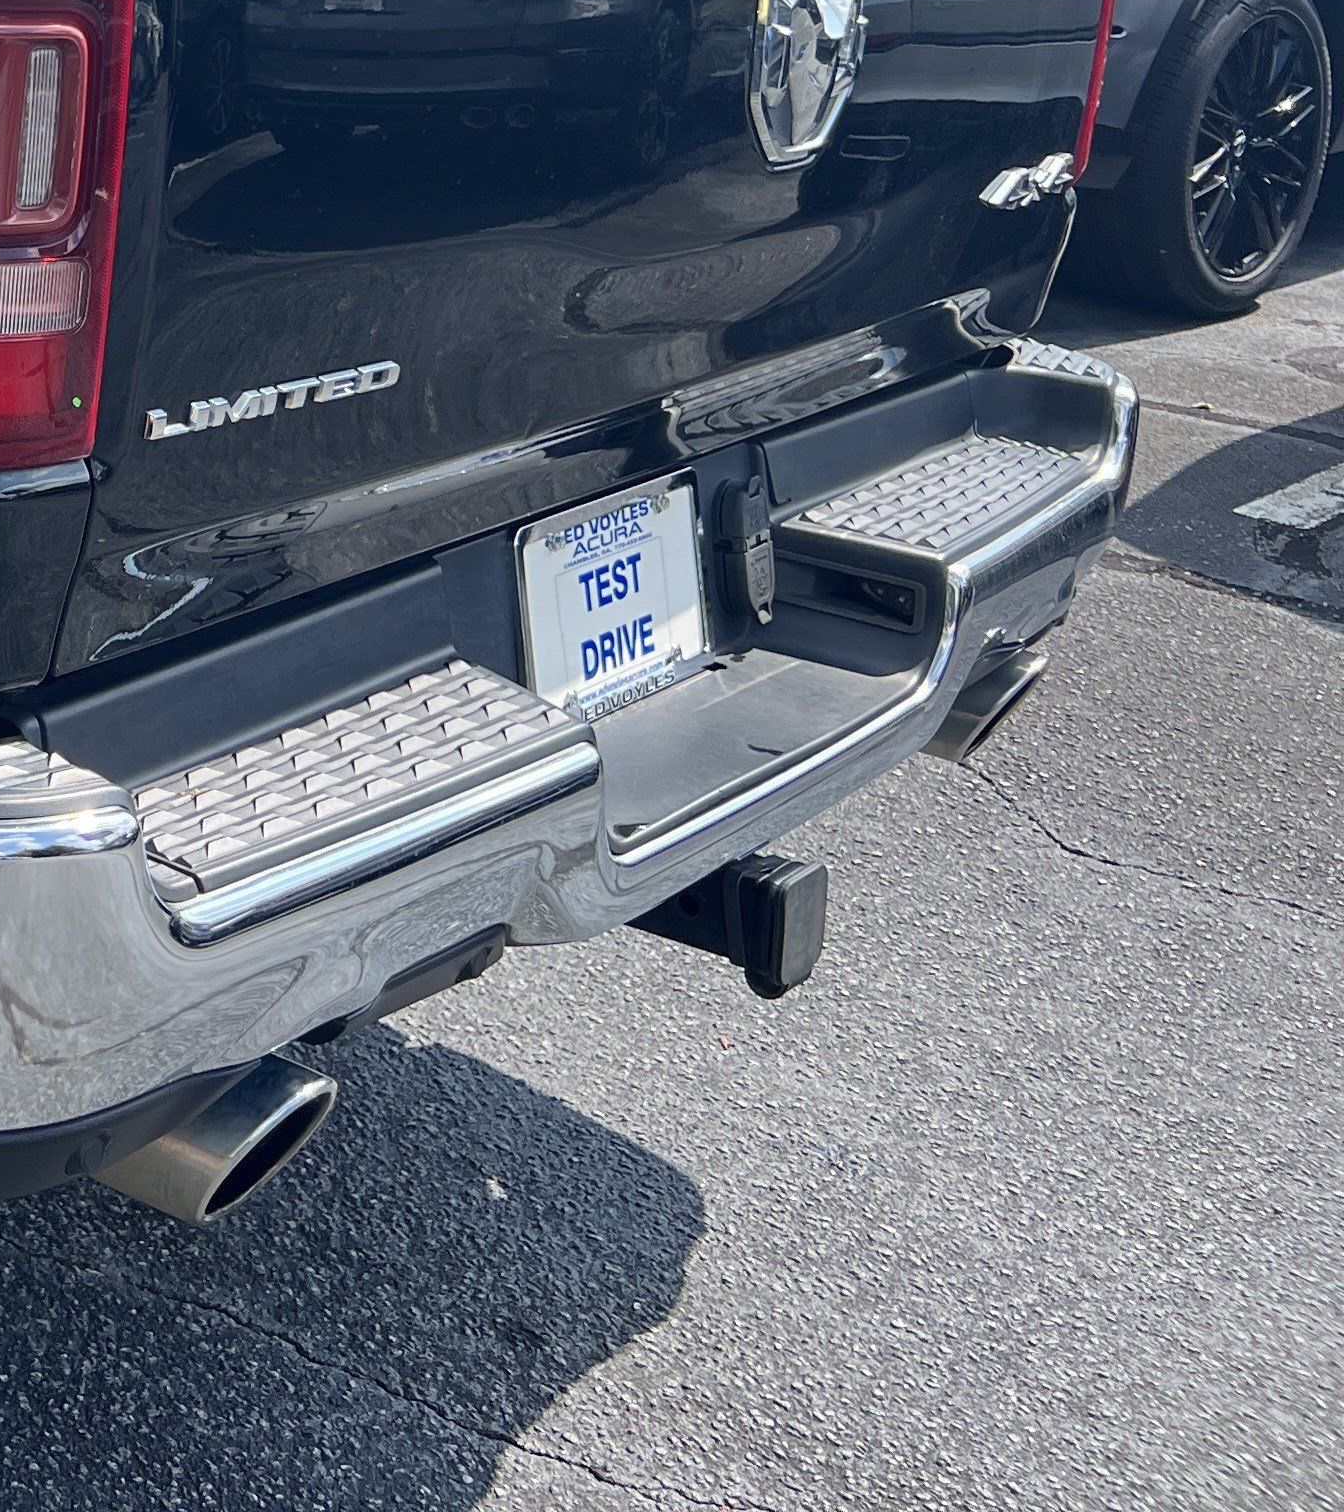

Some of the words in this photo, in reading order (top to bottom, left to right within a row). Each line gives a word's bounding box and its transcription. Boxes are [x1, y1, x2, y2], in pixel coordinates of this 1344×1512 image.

[143, 360, 401, 440] LIMITED
[564, 522, 585, 546] ED
[587, 499, 650, 541] VOYLES
[573, 521, 643, 559] ACURA
[578, 552, 642, 613] TEST
[581, 613, 656, 683] DRIVE
[584, 702, 606, 721] ED
[610, 669, 676, 710] VOYLES
